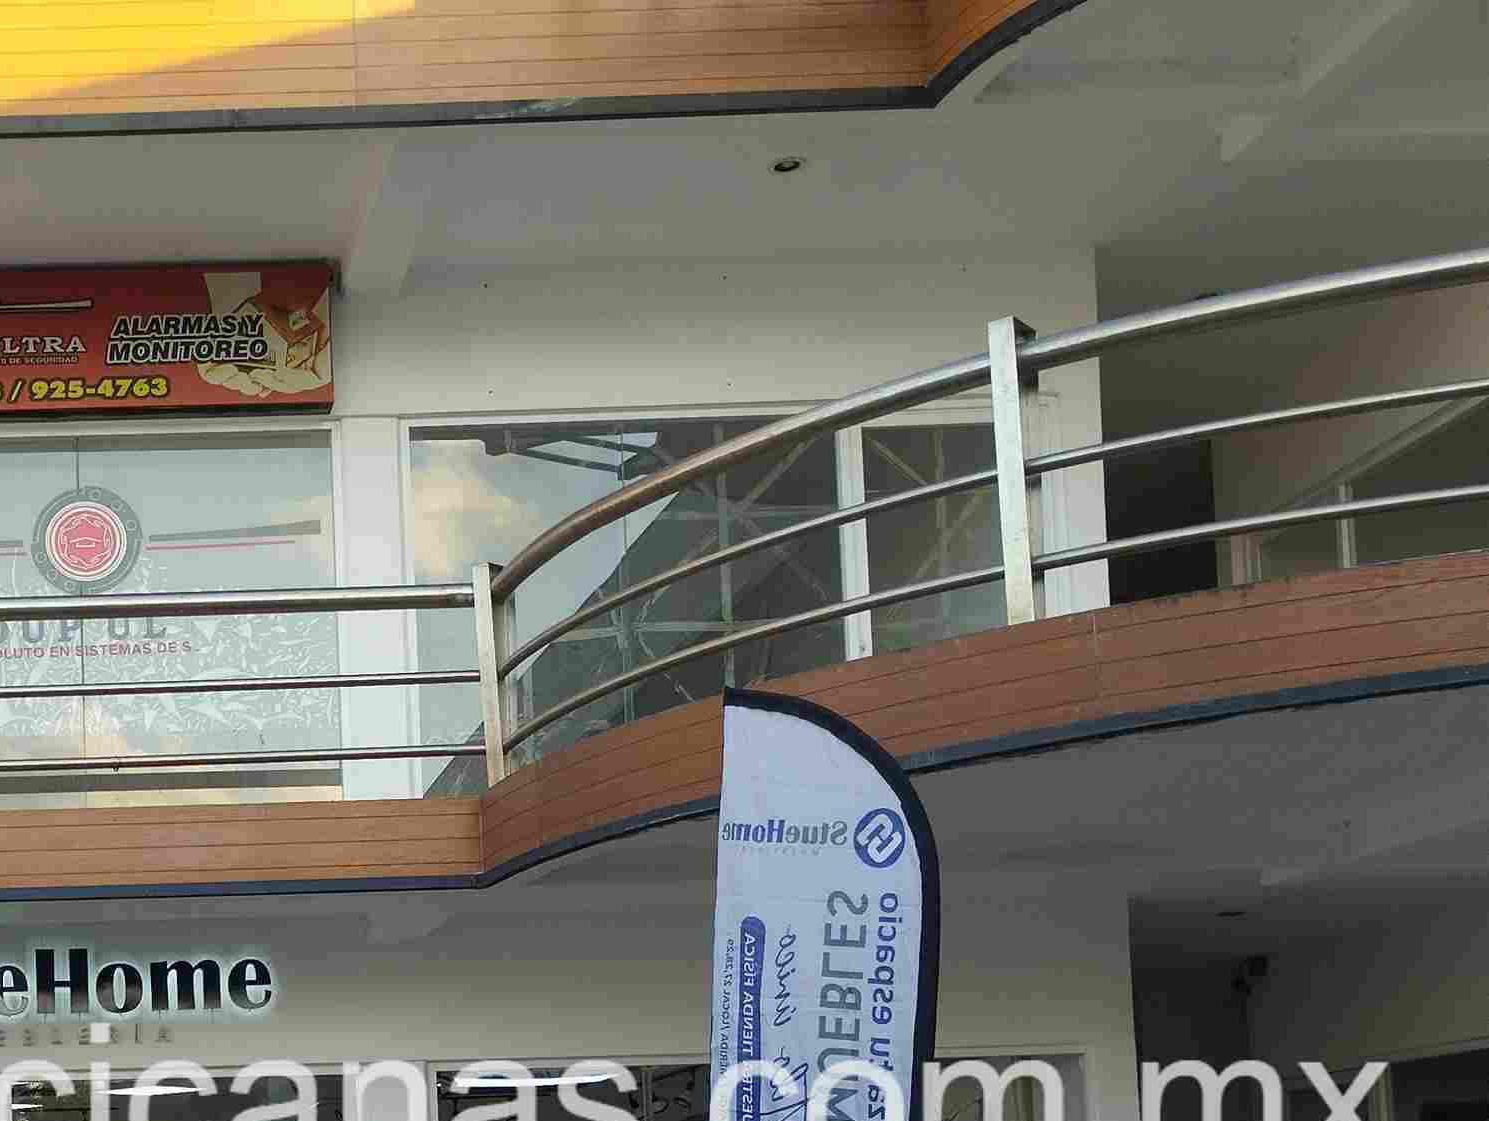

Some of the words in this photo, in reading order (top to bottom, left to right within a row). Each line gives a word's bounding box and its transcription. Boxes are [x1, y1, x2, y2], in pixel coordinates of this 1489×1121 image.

[111, 315, 239, 337] ALARMAS
[107, 338, 269, 364] MONITOREO
[30, 377, 168, 400] 925-4763
[49, 645, 71, 658] EN
[75, 643, 151, 658] SISTEMAS
[156, 641, 176, 654] DE
